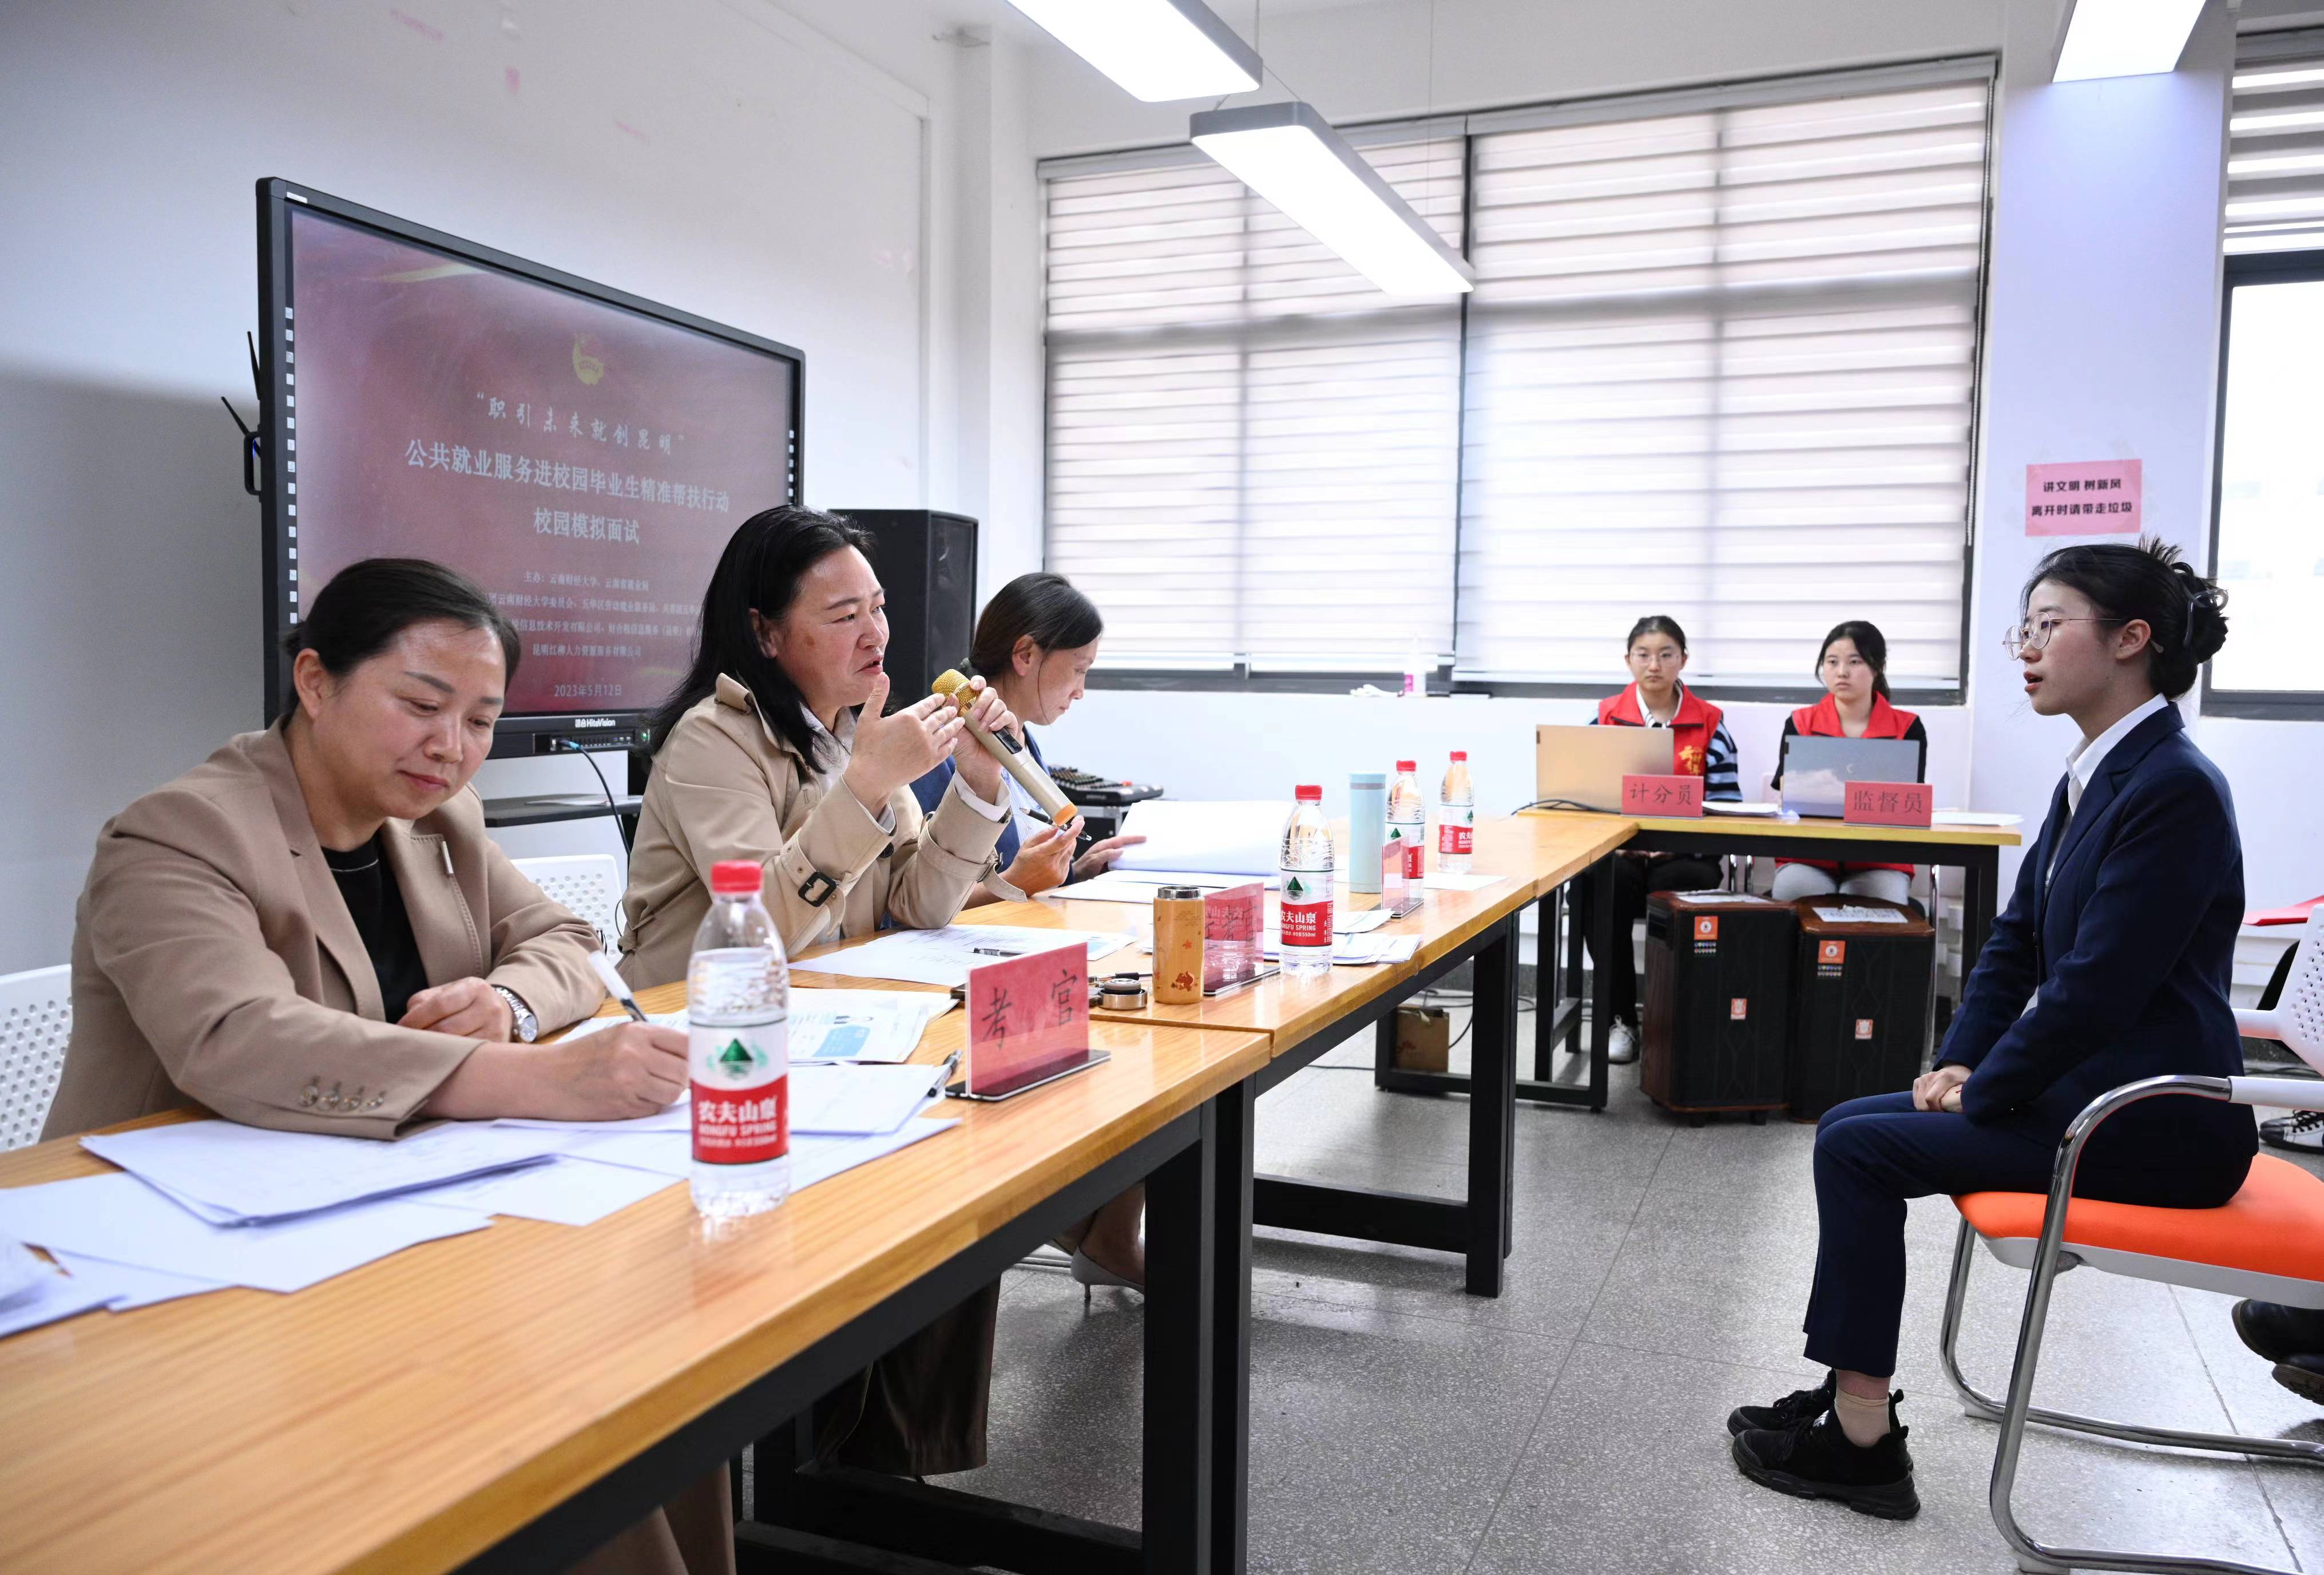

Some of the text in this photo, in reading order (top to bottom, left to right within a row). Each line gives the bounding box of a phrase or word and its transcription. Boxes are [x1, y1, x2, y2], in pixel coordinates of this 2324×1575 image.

[404, 438, 729, 513] 公共就业服务进校园毕业生精准帮扶行动
[2043, 478, 2121, 493] 讲文明 树新风
[2032, 501, 2132, 516] 离开时请带走垃圾
[533, 507, 640, 545] 校园模拟面试
[554, 684, 622, 697] 2023年5月12日
[1629, 783, 1692, 806] 计分员
[1853, 790, 1924, 814] 监督员
[982, 969, 1077, 1050] 考官
[697, 1097, 777, 1123] 农夫山泉
